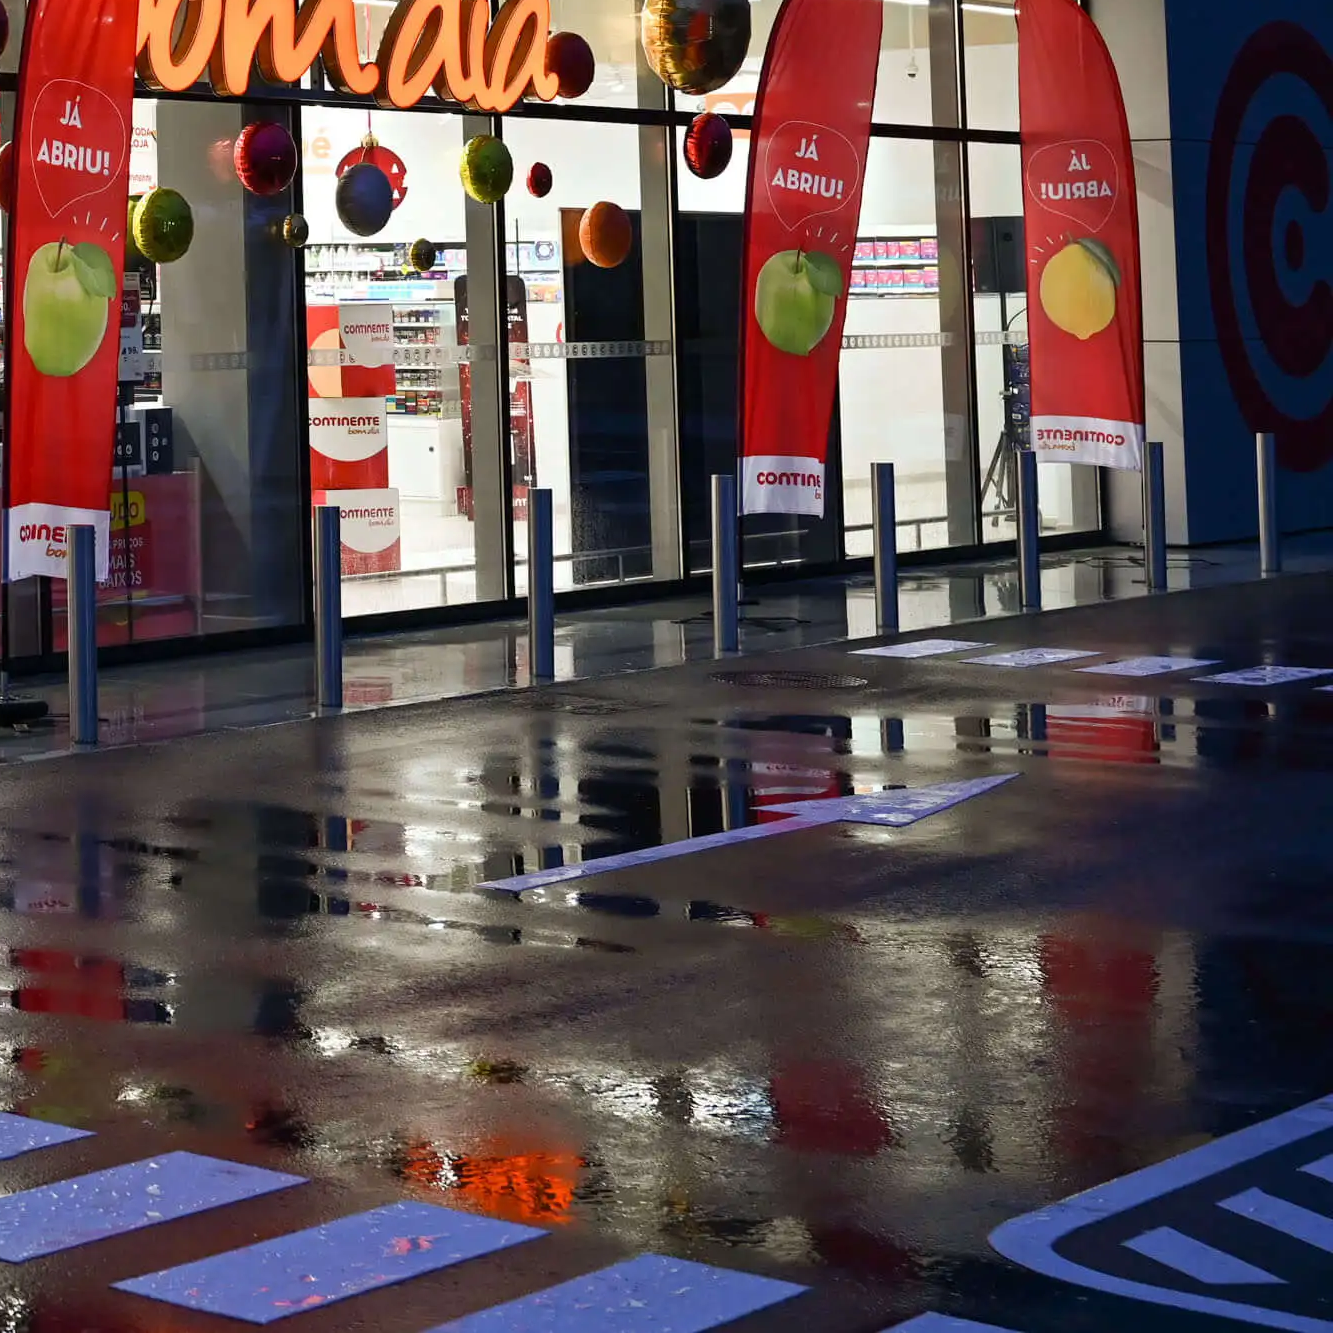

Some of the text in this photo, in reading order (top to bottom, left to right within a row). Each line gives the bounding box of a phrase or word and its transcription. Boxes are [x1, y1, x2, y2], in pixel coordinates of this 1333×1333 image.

[59, 95, 82, 129] JÁ
[36, 137, 110, 177] ABRIU!
[794, 133, 819, 162] JÁ
[771, 167, 844, 200] ABRIU!
[343, 323, 390, 335] CONTINENTE
[340, 507, 394, 519] ONTINENTE
